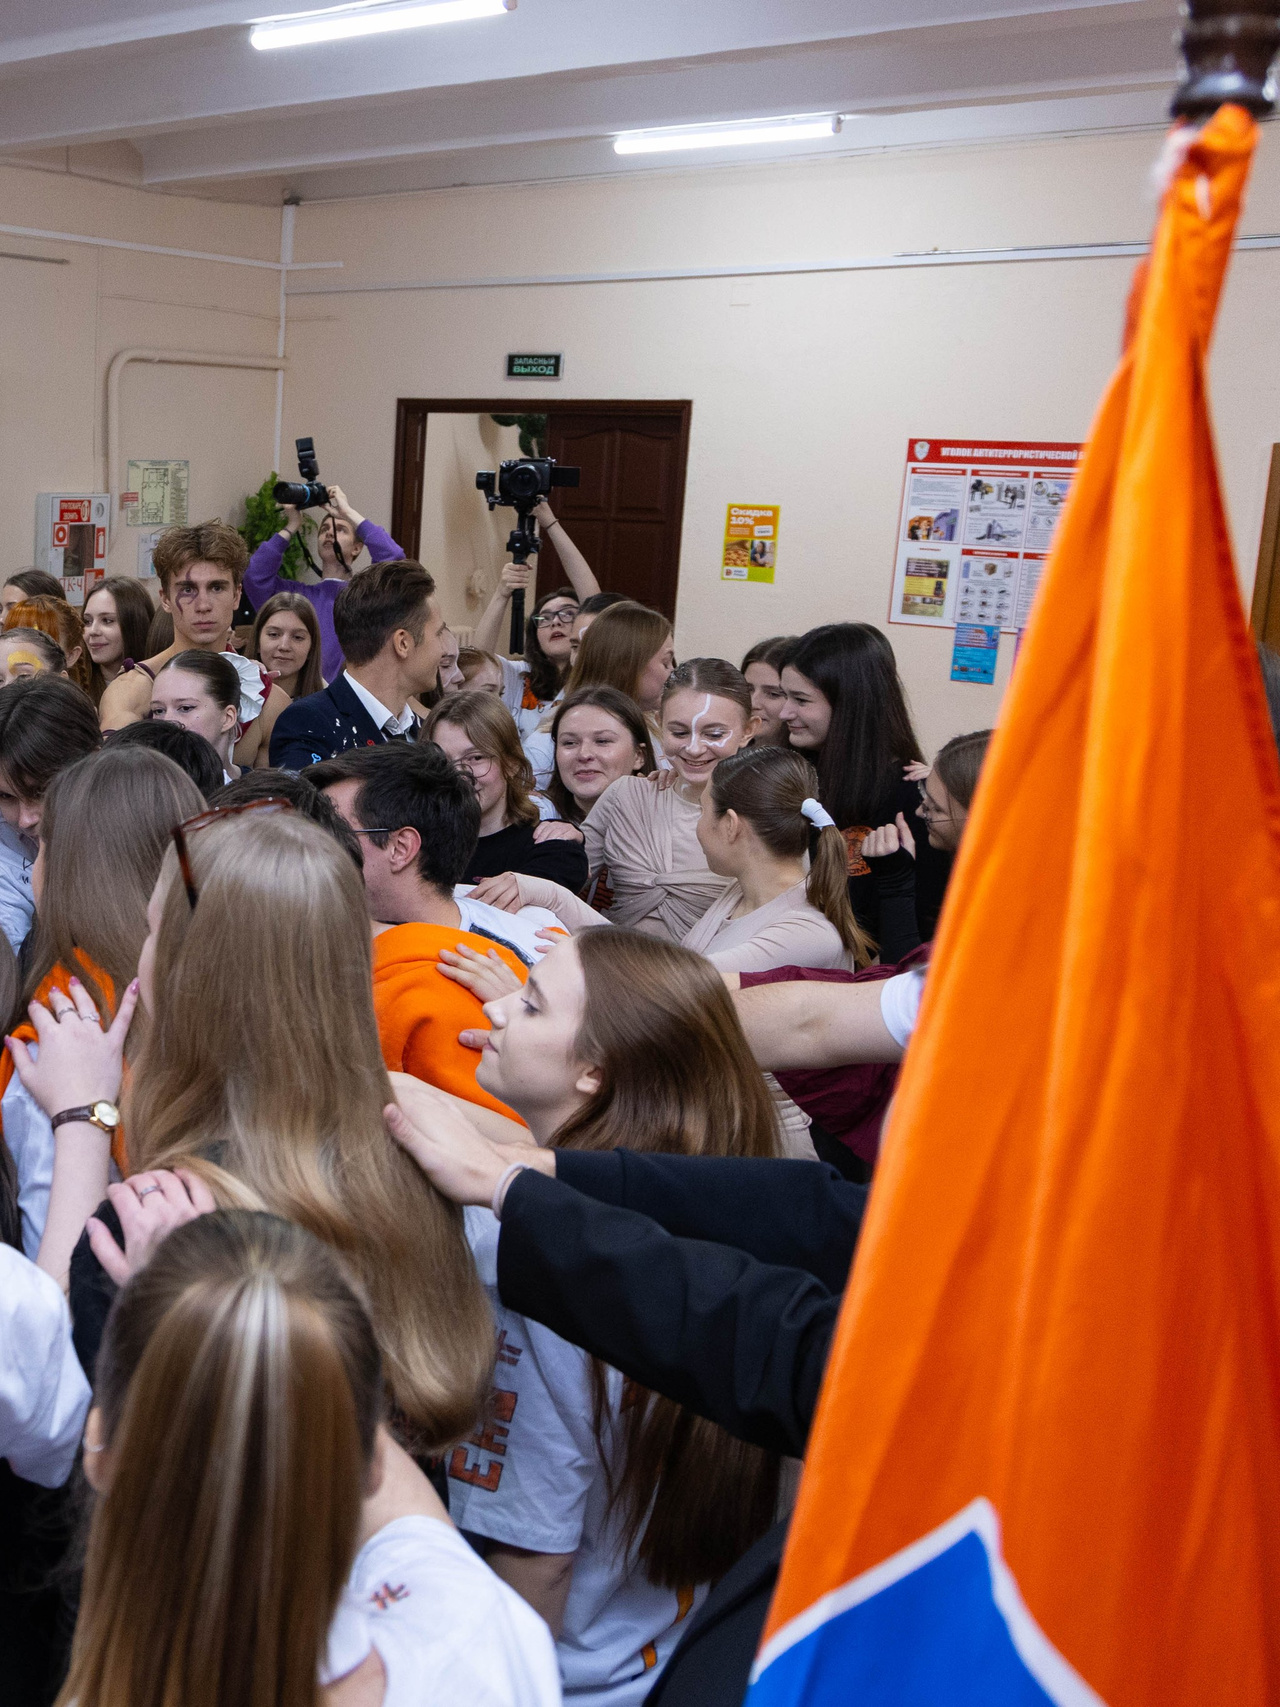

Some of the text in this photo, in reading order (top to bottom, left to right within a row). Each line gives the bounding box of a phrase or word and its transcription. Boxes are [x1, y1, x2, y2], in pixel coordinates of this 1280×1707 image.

[513, 357, 556, 365] ЗАПАСНЫЙ
[512, 365, 555, 375] ВЫХОД
[941, 447, 973, 457] УГОЛОК
[973, 448, 1077, 461] АНТИТЕРРОРИСТИЧЕСКОЙ
[730, 507, 773, 518] Скидка
[730, 516, 755, 525] 10%
